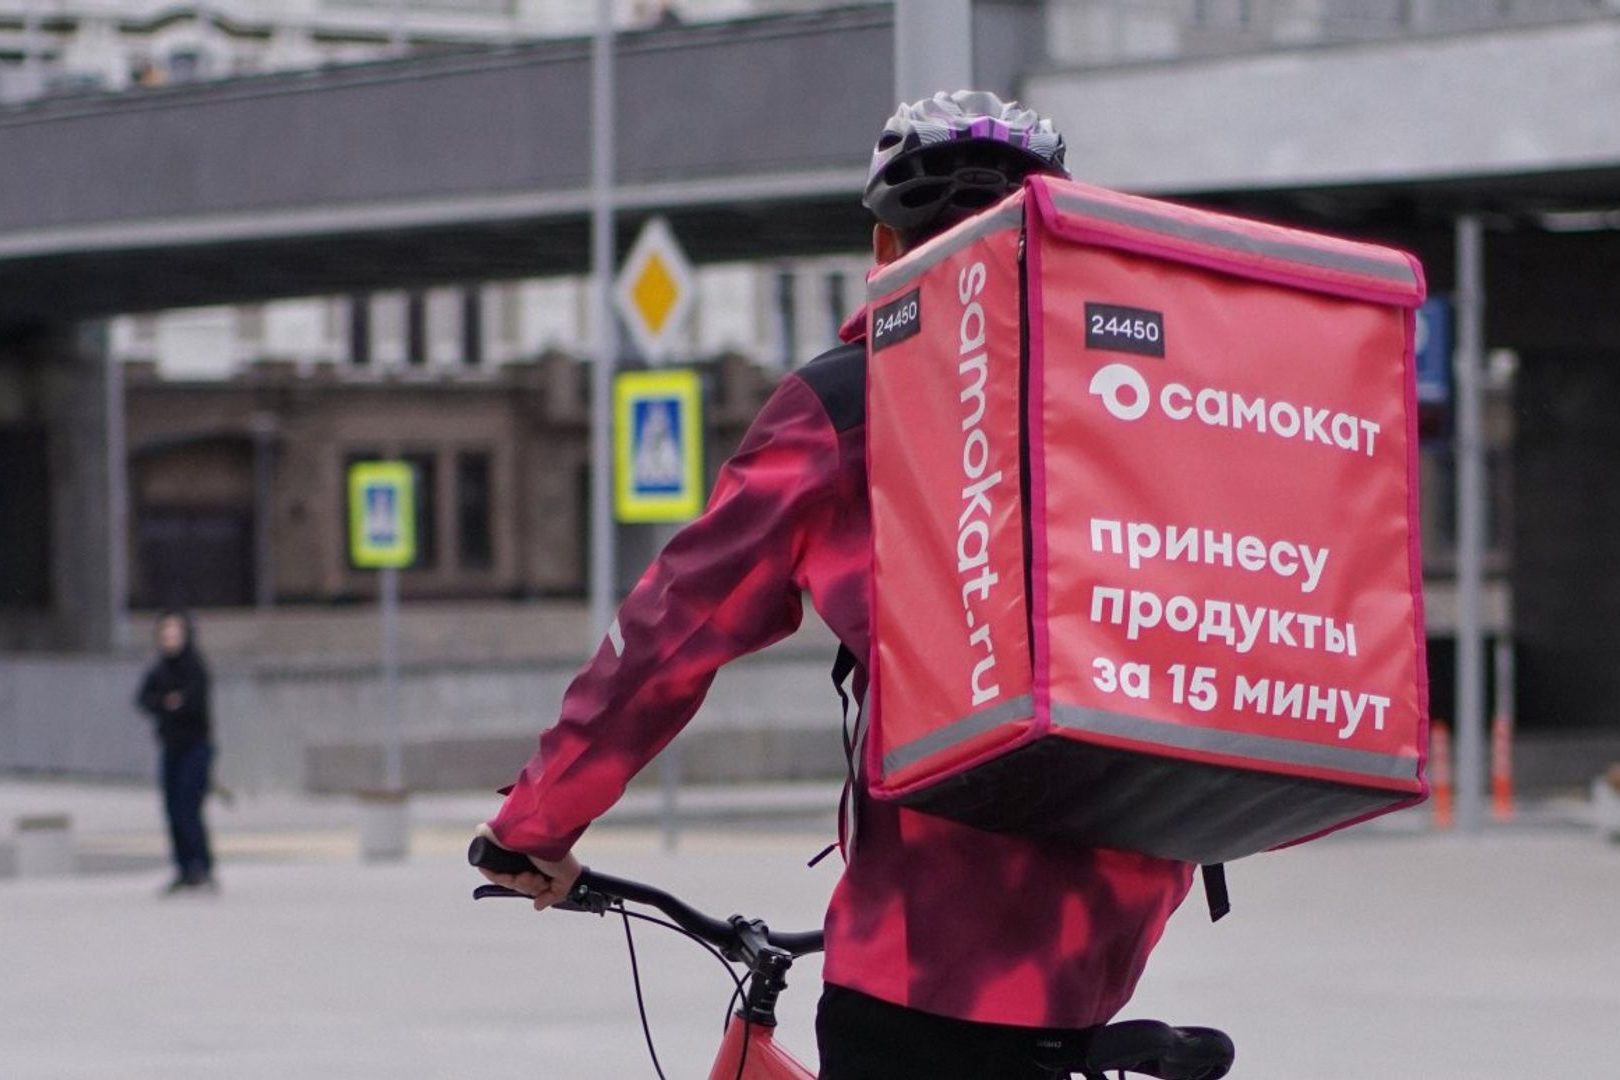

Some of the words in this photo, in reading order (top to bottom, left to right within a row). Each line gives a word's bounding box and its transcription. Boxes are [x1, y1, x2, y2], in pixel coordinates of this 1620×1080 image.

[875, 302, 919, 339] 24450
[1091, 315, 1160, 343] 24450
[1161, 382, 1381, 457] самокат
[956, 261, 1003, 706] samokat.ru
[1090, 518, 1329, 593] принесу
[1090, 586, 1358, 657] продукты
[1092, 656, 1150, 700] за
[1166, 664, 1218, 712] 15
[1234, 675, 1391, 740] минут
